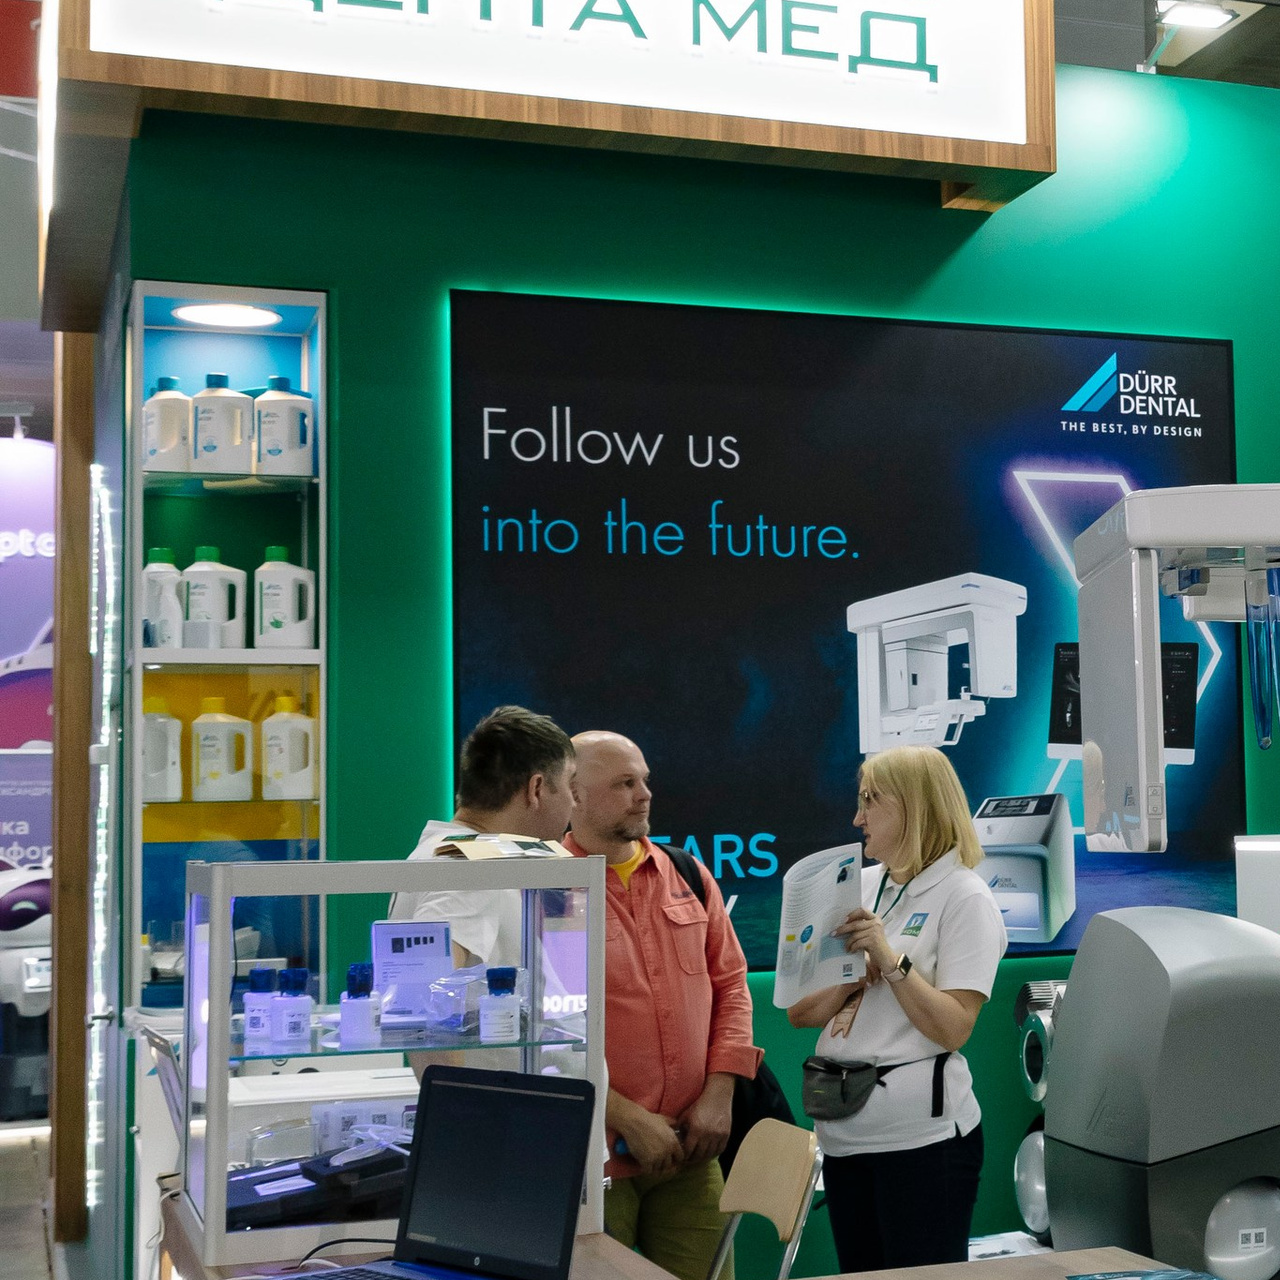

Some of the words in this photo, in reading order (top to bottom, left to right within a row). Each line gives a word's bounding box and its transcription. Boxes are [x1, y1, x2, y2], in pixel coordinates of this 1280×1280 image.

[1119, 370, 1177, 395] DÜRR
[1120, 395, 1201, 418] DENTAL
[482, 405, 664, 466] Follow
[687, 434, 740, 469] us
[1060, 421, 1086, 432] THE
[1092, 422, 1128, 435] BEST,
[1132, 425, 1148, 435] BY
[1153, 426, 1202, 437] DESIGN
[482, 505, 579, 553] into
[604, 497, 685, 556] the
[708, 500, 859, 559] future.
[648, 832, 779, 879] ARS
